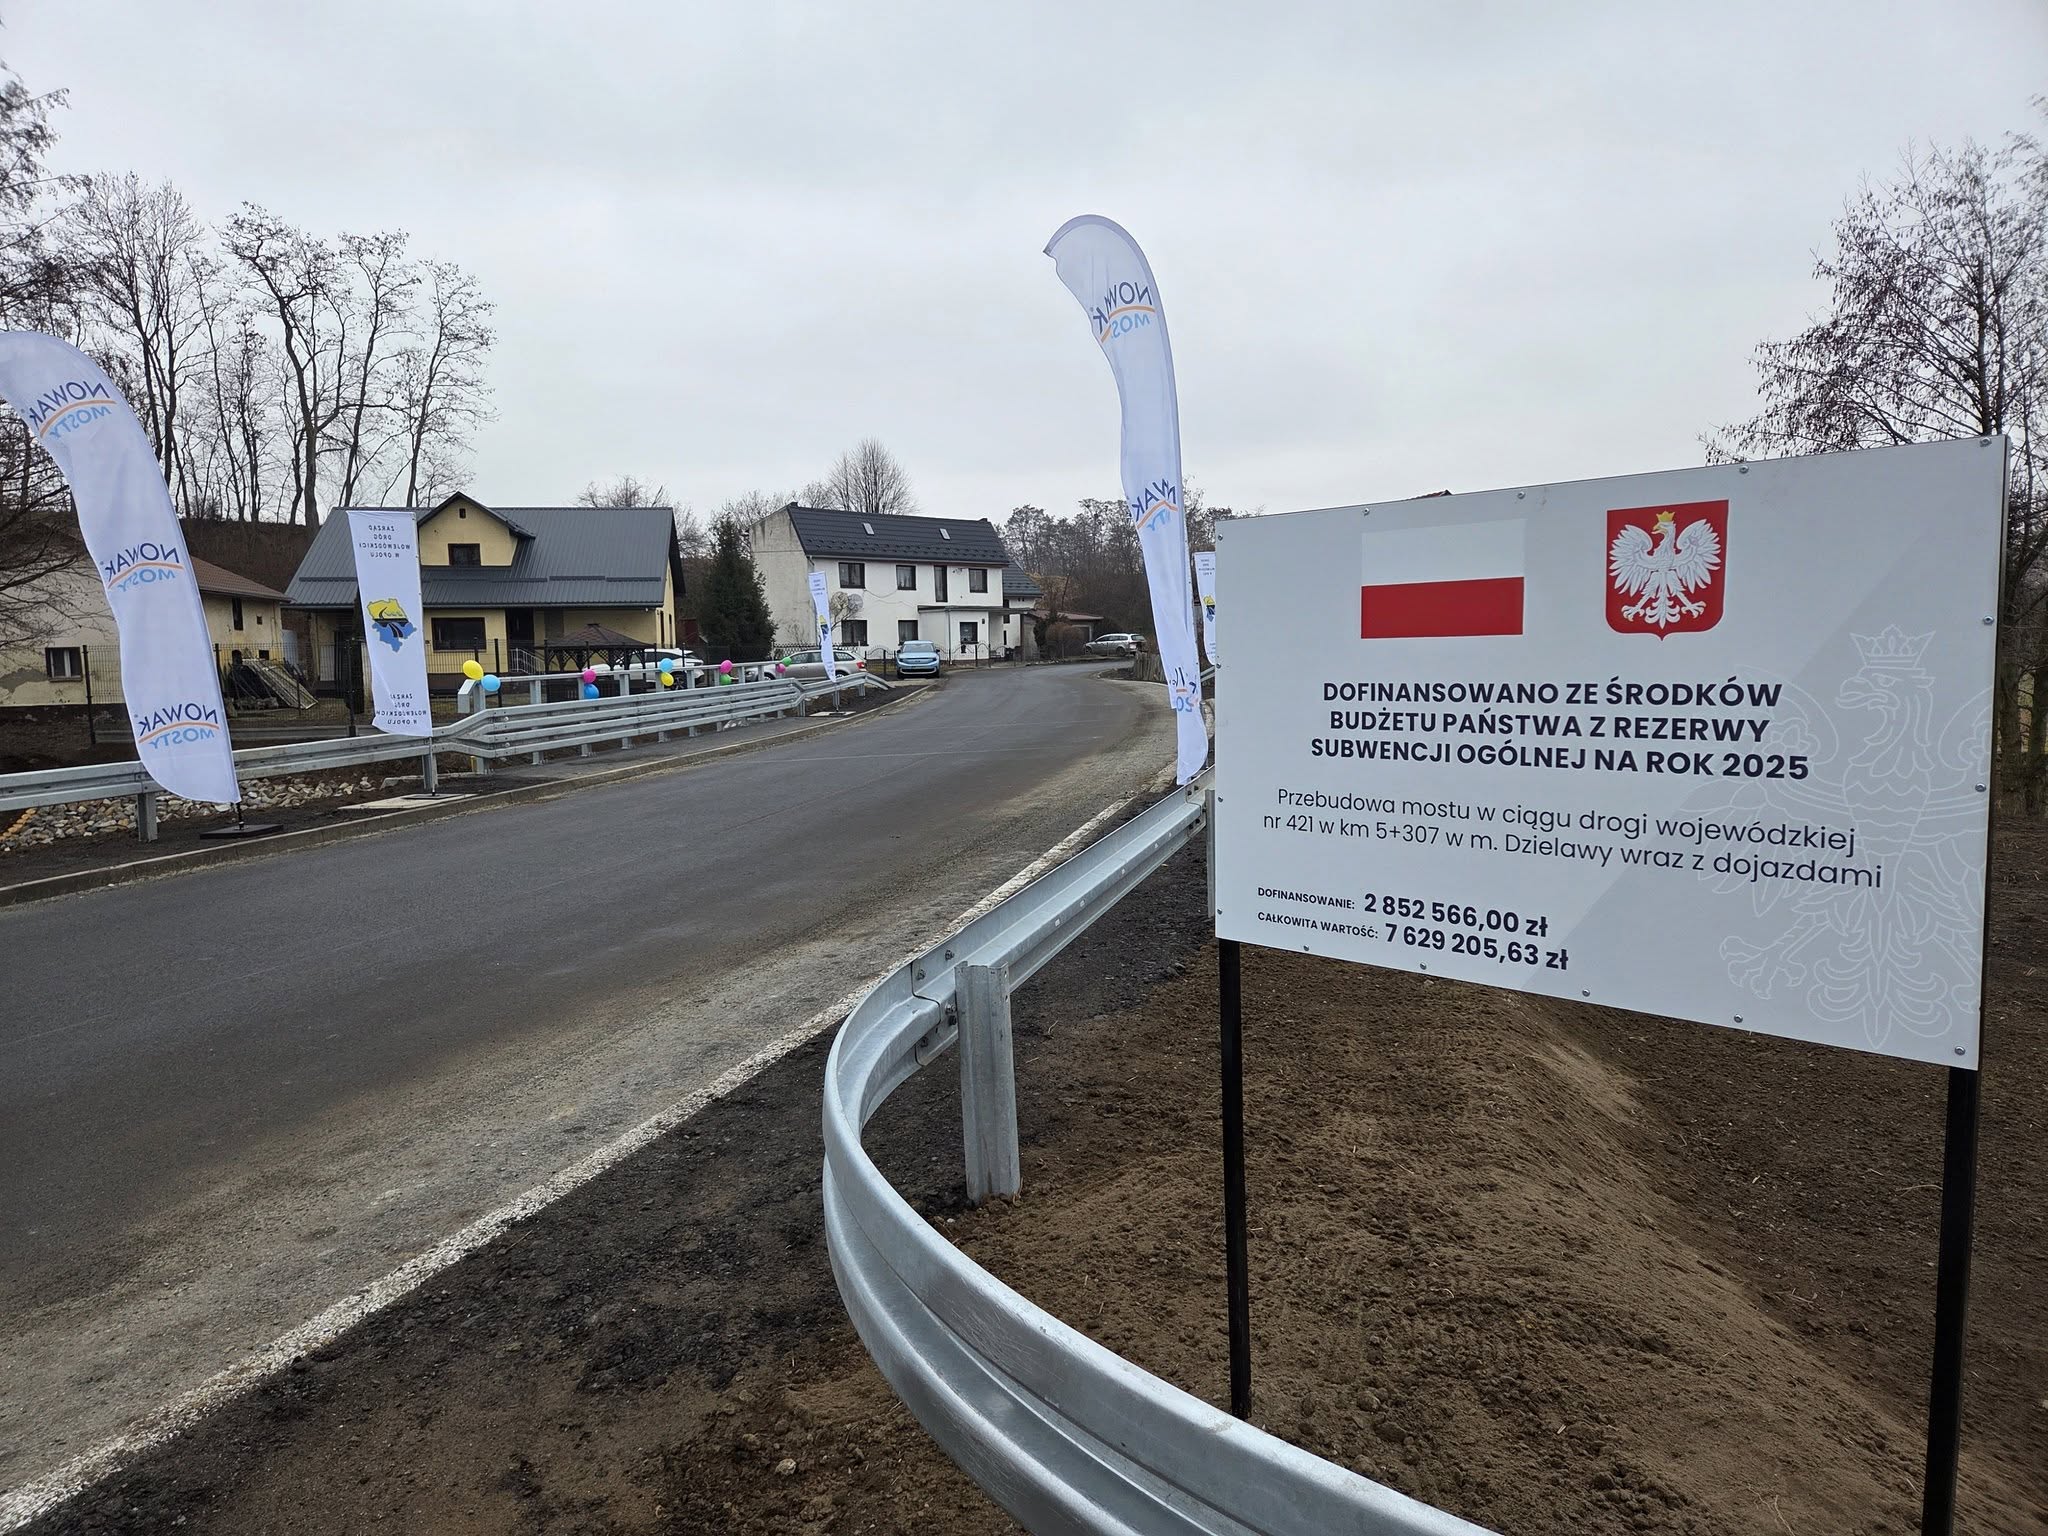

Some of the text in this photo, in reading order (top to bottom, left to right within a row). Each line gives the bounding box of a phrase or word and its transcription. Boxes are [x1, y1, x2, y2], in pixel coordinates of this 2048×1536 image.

[1323, 675, 1783, 707] DOFINANSOWANO ZE ŚRODKÓW
[1330, 706, 1771, 743] BUDŻETU PAŃSTWA Z REZERWY
[1311, 737, 1809, 781] SUBWENCJI OGÓLNEJ NA ROK 2025
[1278, 788, 1856, 859] Przebudowa mostu w ciągu drogi wojewódzkiej
[1263, 814, 1882, 889] nr 421 w km 5+307 w m. Dzielawy wraz z dojazdami
[1257, 886, 1549, 938] DOFINANSOWANIE: 2 852 566,00 zł
[1257, 911, 1569, 971] CAŁKOWITA WARTOŚĆ: 7 629 205,63 zł
